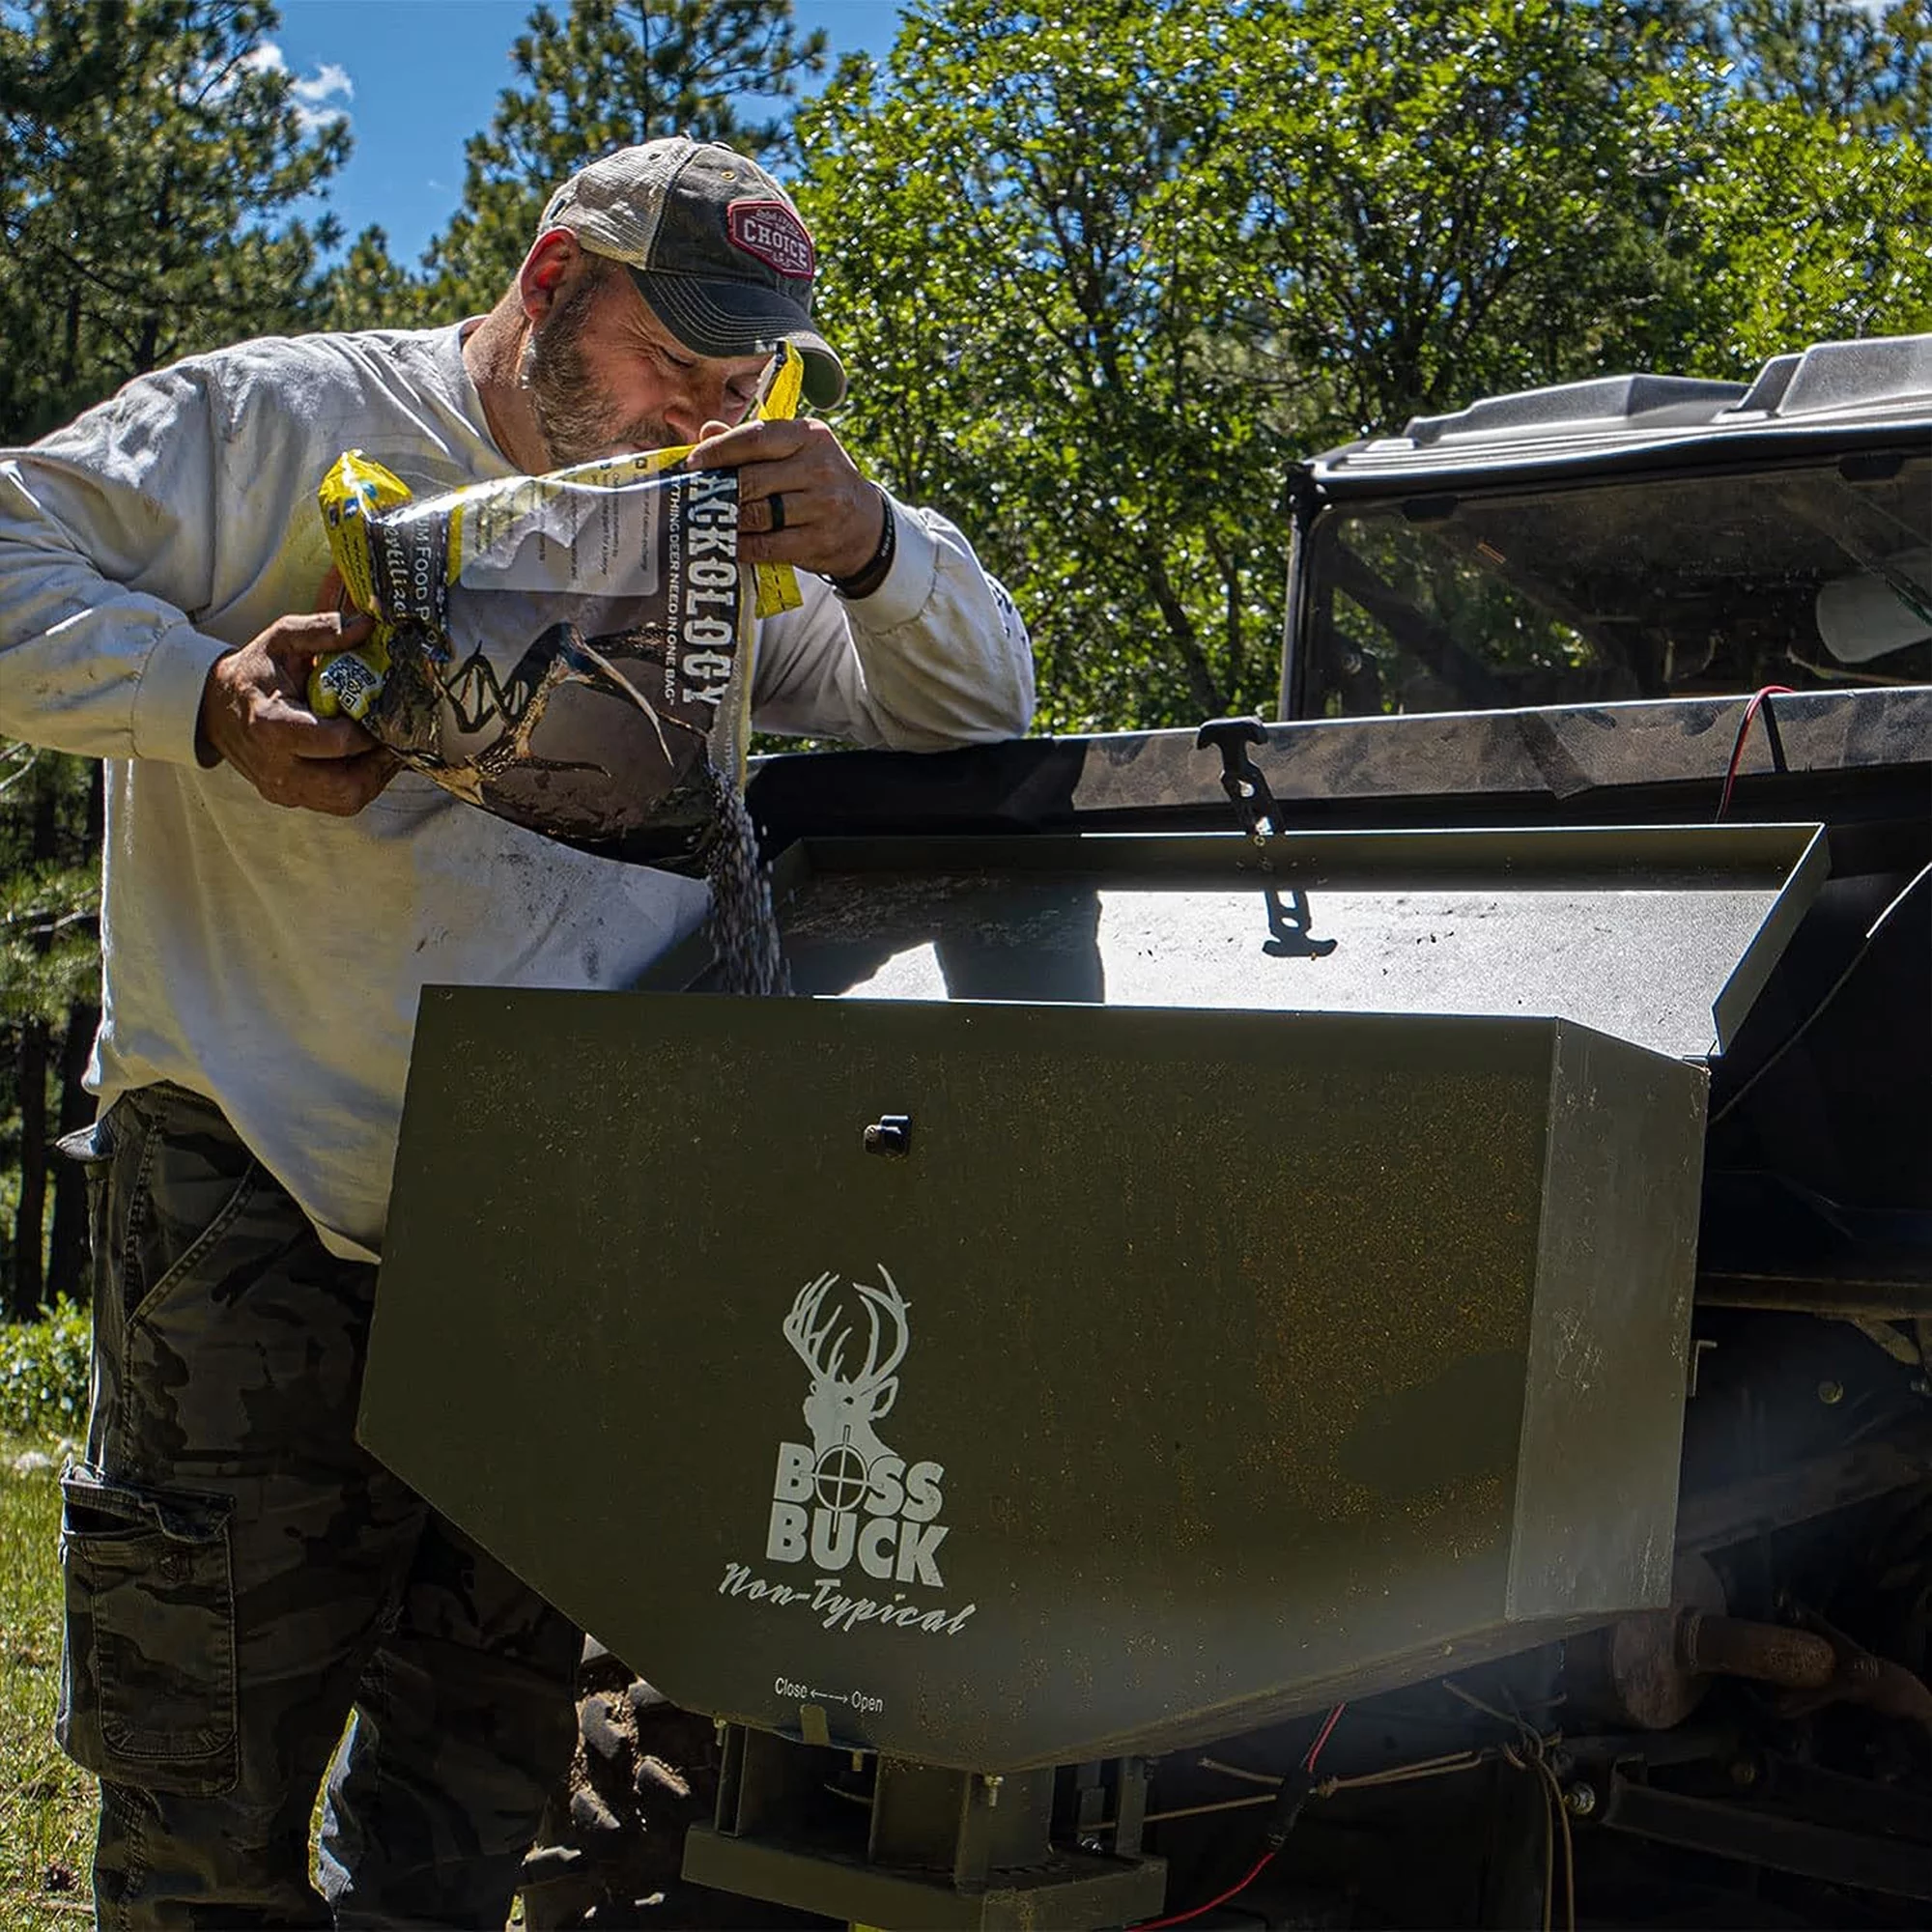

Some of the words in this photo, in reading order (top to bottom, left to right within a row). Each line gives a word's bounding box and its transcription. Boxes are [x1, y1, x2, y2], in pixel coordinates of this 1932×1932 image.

[743, 218, 808, 269] CHOICE
[669, 483, 681, 533] YTHING
[414, 546, 432, 601] FOOD
[668, 533, 680, 572] DEER
[668, 573, 680, 613] NEED
[682, 474, 738, 704] ACKOLOGY
[665, 634, 677, 666] ONE
[668, 616, 678, 634] IN
[773, 1441, 946, 1522] BOSS
[766, 1500, 950, 1588] BUCK
[718, 1561, 977, 1635] Non-Typical
[775, 1677, 809, 1699] Close
[851, 1690, 884, 1713] Open
